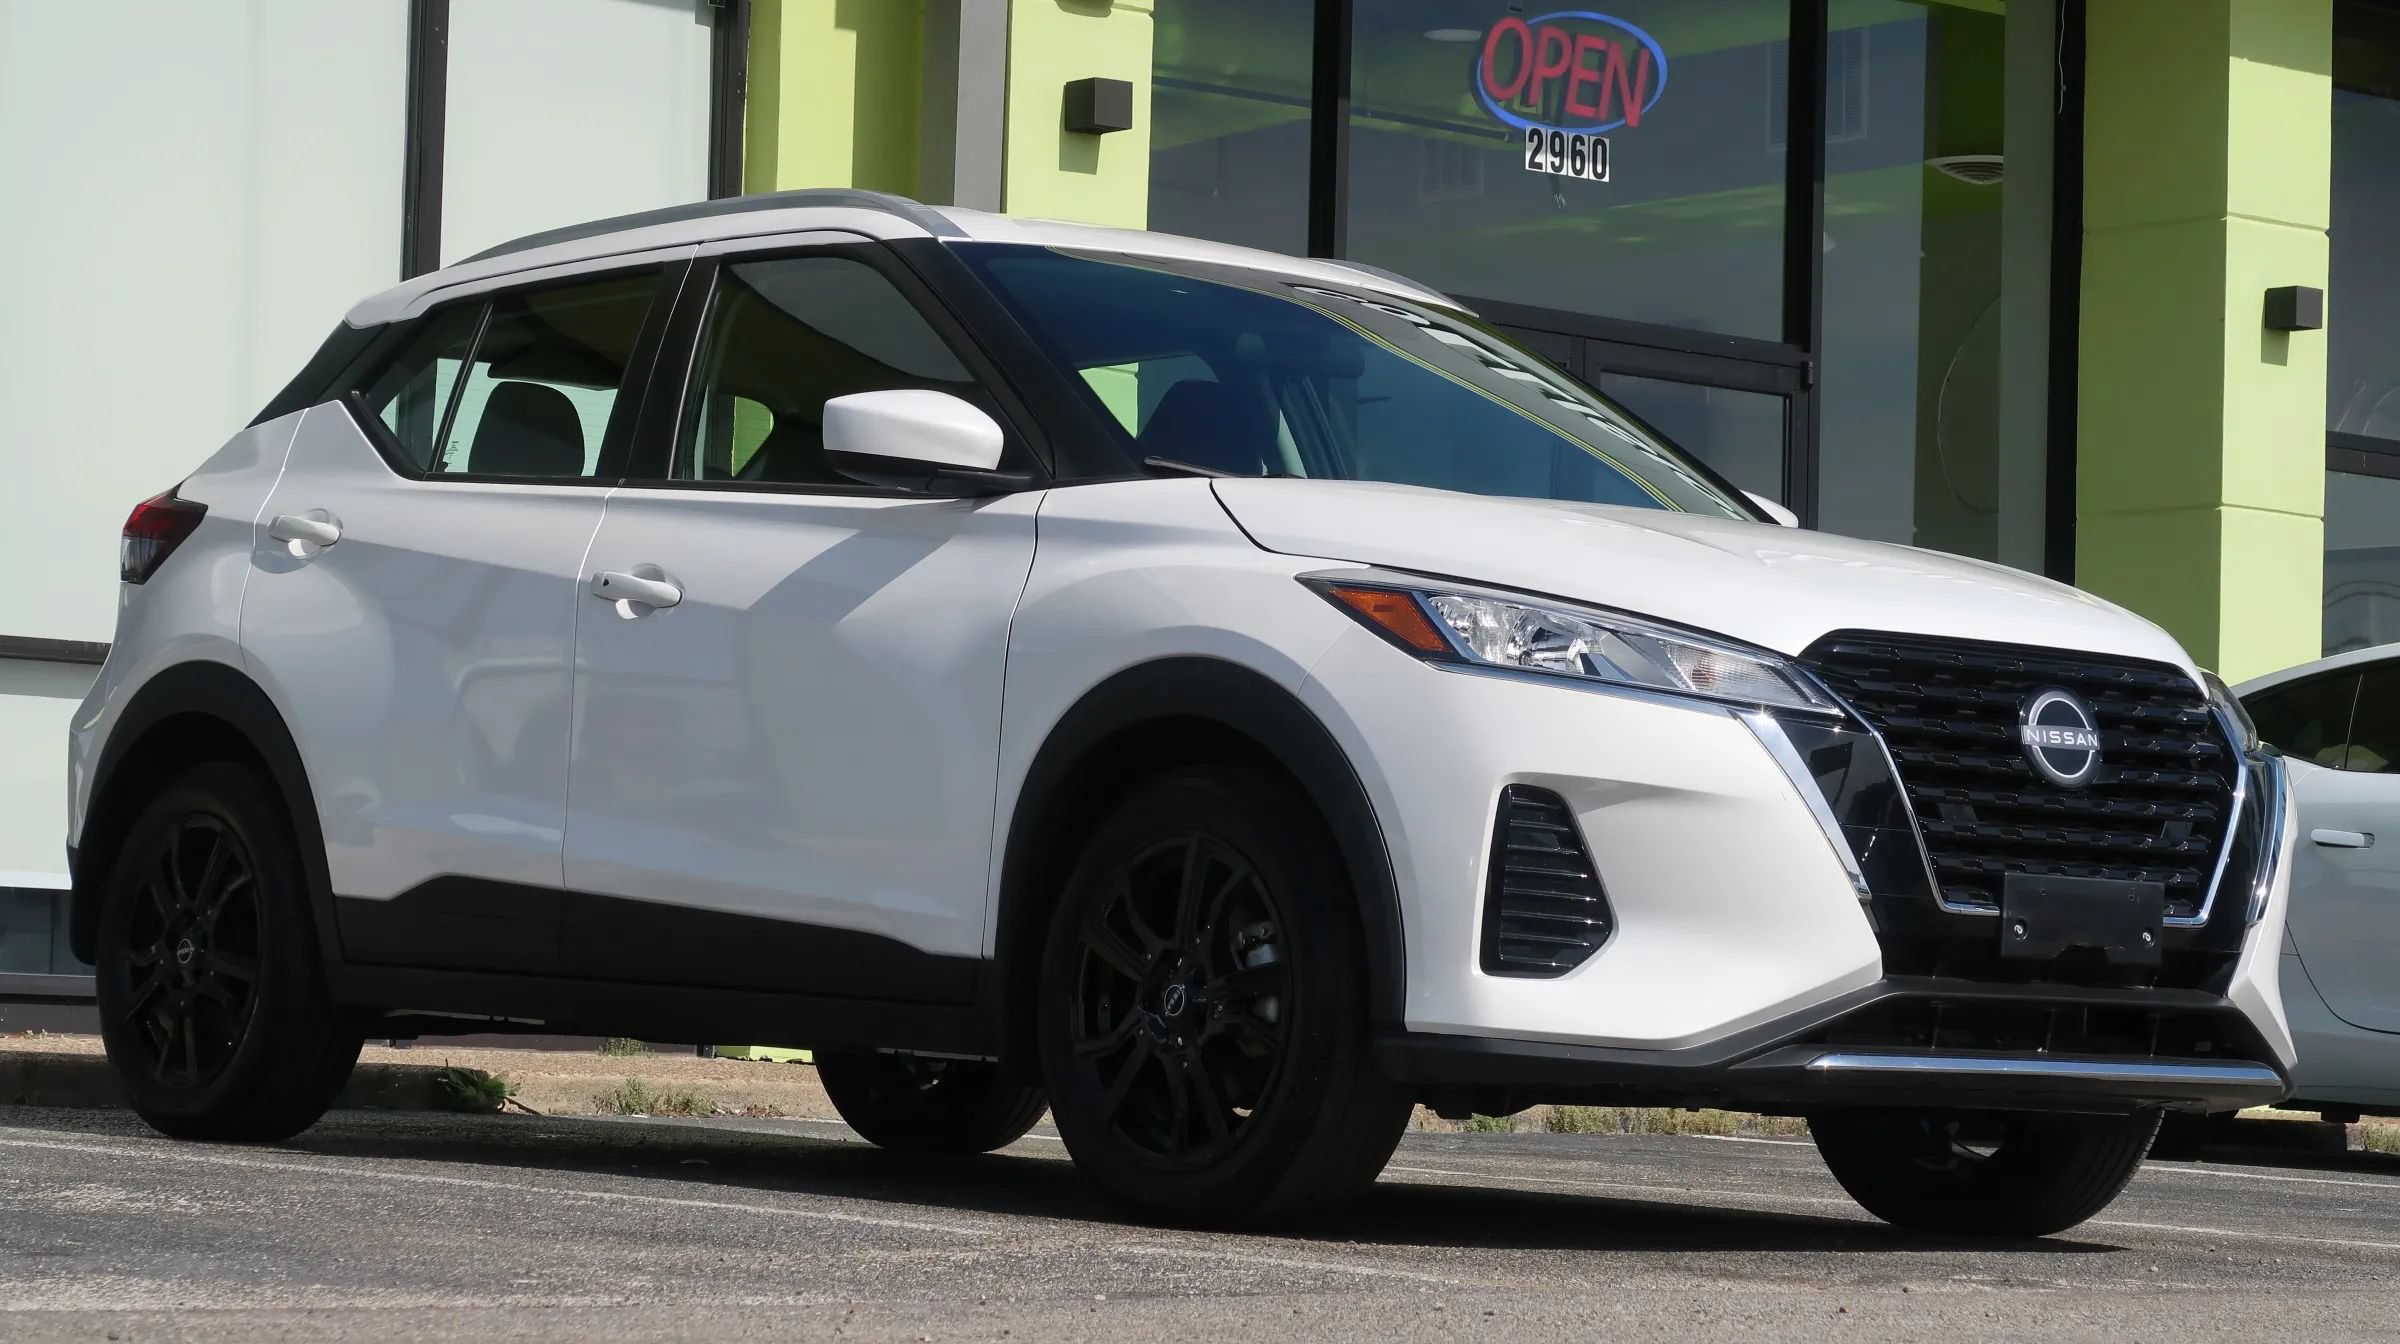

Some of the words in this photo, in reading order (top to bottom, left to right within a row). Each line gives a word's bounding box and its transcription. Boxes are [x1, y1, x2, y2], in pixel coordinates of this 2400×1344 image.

[1483, 16, 1650, 128] OPEN
[1527, 128, 1608, 180] 2960
[2026, 729, 2098, 747] NISSAN
